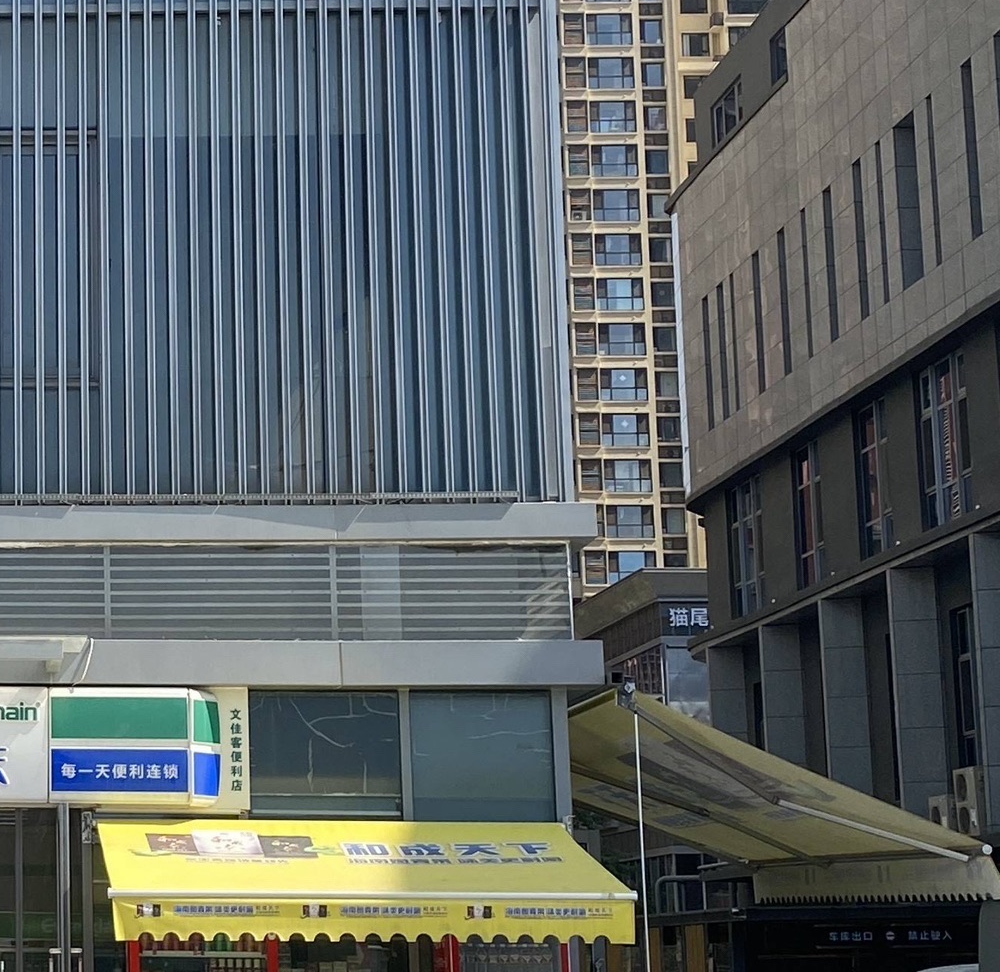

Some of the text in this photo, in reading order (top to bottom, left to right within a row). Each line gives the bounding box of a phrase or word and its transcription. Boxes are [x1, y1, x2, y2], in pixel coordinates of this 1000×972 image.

[229, 708, 243, 792] 文佳客便利店
[60, 763, 179, 780] 每一天便利连锁
[342, 841, 550, 856] 和成天下
[828, 930, 953, 942] 车库出口 禁止驶入
